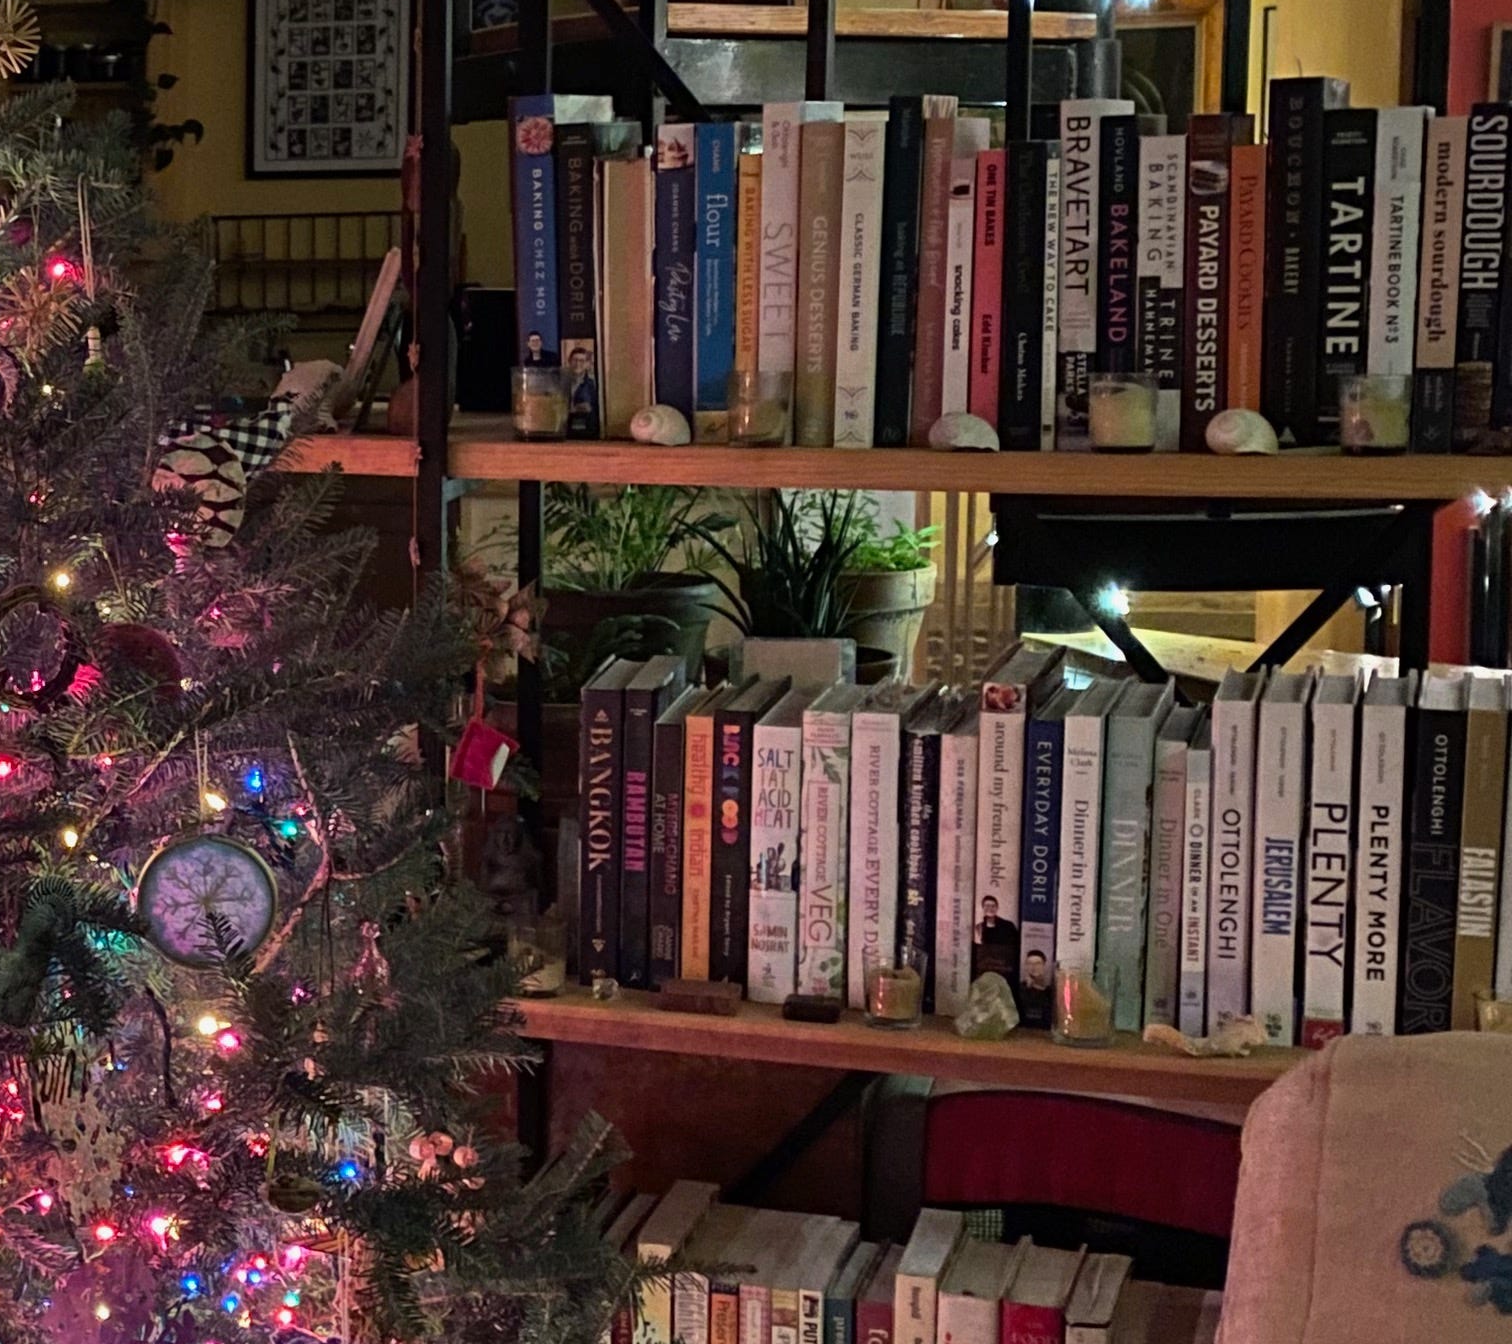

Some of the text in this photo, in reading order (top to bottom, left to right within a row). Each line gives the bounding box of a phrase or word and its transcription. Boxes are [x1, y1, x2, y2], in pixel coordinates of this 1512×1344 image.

[568, 158, 583, 233] BAKING
[1048, 172, 1058, 197] THE
[1113, 126, 1125, 193] HOVLAND
[1284, 97, 1302, 295] BOUCHON BAKERY
[1433, 141, 1454, 224] modern
[1462, 115, 1508, 289] SOURDOUGH
[532, 168, 547, 316] BAKING CHEZ MOI
[706, 193, 728, 247] flour
[984, 164, 997, 246] ONE TIN BAKES
[1047, 203, 1057, 235] NEW
[1065, 115, 1091, 296] BRAVETART
[1148, 163, 1164, 262] BAKING
[1165, 152, 1179, 270] SCANDINAVIAN
[1238, 174, 1258, 245] PAYARD
[1388, 195, 1404, 260] TARTINE
[570, 261, 585, 322] DORIE
[740, 187, 756, 353] BAKING WITH LESS SUGAR
[763, 222, 793, 340] SWEET
[811, 216, 828, 284] GENIUS
[849, 212, 865, 352] CLASSIC GERMAN BAKING
[1045, 275, 1055, 292] TO
[1046, 239, 1056, 271] WAY
[1108, 203, 1129, 343] BAKELAND
[1326, 177, 1365, 354] TARTINE
[1386, 263, 1401, 308] BOOK
[1423, 229, 1449, 343] sourdough
[807, 288, 826, 374] DESSERTS
[950, 264, 963, 350] snacking cakes
[1044, 296, 1055, 333] CAKE
[1158, 298, 1176, 380] TRINE
[1195, 205, 1220, 412] PAYARD DESSERTS
[1066, 356, 1077, 393] PARKS
[1076, 352, 1088, 396] STELLA
[588, 727, 613, 871] BANGKOK
[689, 733, 709, 794] healthy
[757, 748, 794, 769] SALT
[757, 788, 792, 809] ACID
[1430, 734, 1449, 835] OTTOLENGHI
[625, 771, 647, 872] RAMBUTAN
[653, 793, 665, 853] AT HOME
[754, 809, 794, 829] HEAT
[864, 745, 880, 925] RIVER COTTAGE EVERY
[989, 721, 1008, 888] around my french table
[1031, 742, 1052, 904] EVERYDAY DORIE
[808, 786, 833, 943] RIVER COTTAGE VEG
[1070, 799, 1088, 943] Dinner in French
[1109, 819, 1138, 933] DINNER
[1155, 818, 1177, 949] Dinner in One
[1189, 841, 1203, 883] DINNER
[1217, 808, 1241, 960] OTTOLENGHI
[1262, 837, 1294, 936] JERUSALEM
[1308, 802, 1348, 967] PLENTY
[1366, 805, 1390, 981] PLENTY MORE
[1458, 847, 1496, 937] FALASTIN
[753, 924, 788, 938] SAMIN
[1187, 916, 1201, 963] INSTANT
[1407, 842, 1458, 1032] FLAVOR
[804, 1321, 818, 1344] PUT
